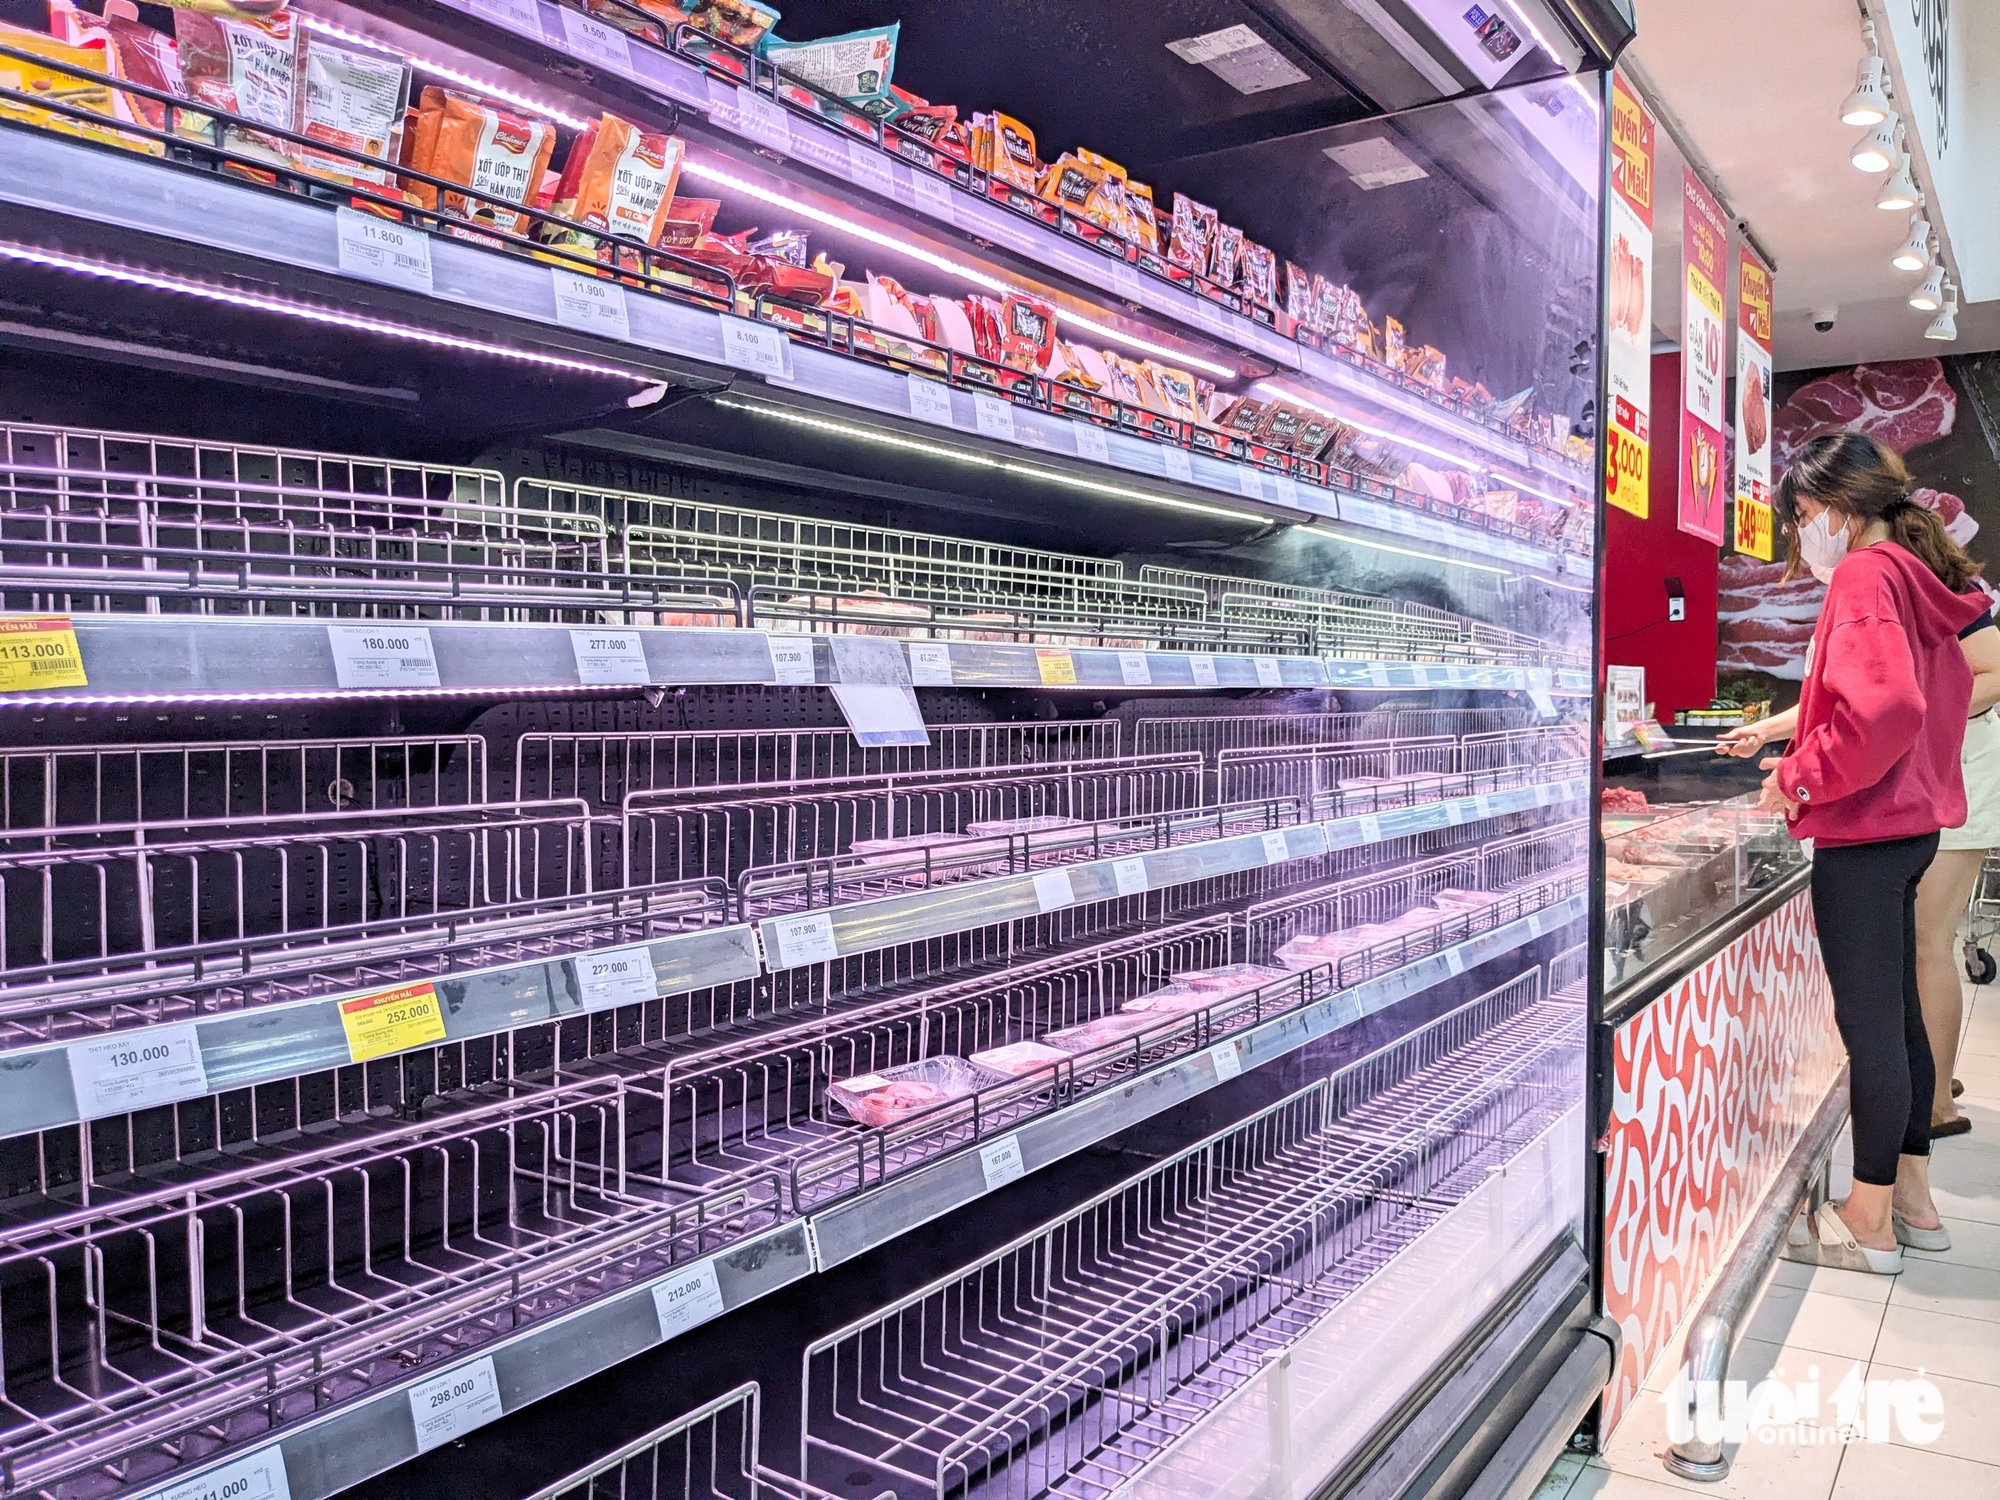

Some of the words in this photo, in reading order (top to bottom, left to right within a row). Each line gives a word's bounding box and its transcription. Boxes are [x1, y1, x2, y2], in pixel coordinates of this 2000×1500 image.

[582, 23, 607, 41] 9.500
[495, 131, 528, 147] Cholimex
[478, 158, 493, 174] XỐT
[494, 161, 511, 178] ƯỚP
[489, 181, 506, 197] HÀN
[617, 169, 633, 185] XỐT
[635, 175, 652, 191] ƯỚP
[652, 181, 666, 197] THỊT
[630, 192, 644, 207] HÀN
[362, 225, 403, 246] 11.800
[572, 281, 605, 298] 11.900
[771, 312, 803, 329] Cholimex
[736, 330, 759, 345] 8.100
[920, 384, 937, 397] 6.700
[0, 643, 65, 660] 113.000
[362, 638, 410, 650] 180.000
[590, 639, 627, 650] 277.000
[775, 652, 802, 662] 107.900
[790, 923, 817, 937] 107.900
[592, 961, 628, 975] 222.000
[373, 992, 400, 1006] KHUYẾN
[400, 990, 413, 999] MÃI
[386, 1003, 430, 1025] 252.000
[88, 1046, 103, 1054] THIT
[118, 1041, 130, 1049] XAY
[110, 1045, 170, 1068] 130.000
[991, 1150, 1012, 1166] 167.000
[668, 1278, 702, 1302] 212.000
[430, 1379, 474, 1408] 298.000
[253, 1467, 264, 1475] vnd
[193, 1483, 207, 1491] HEO
